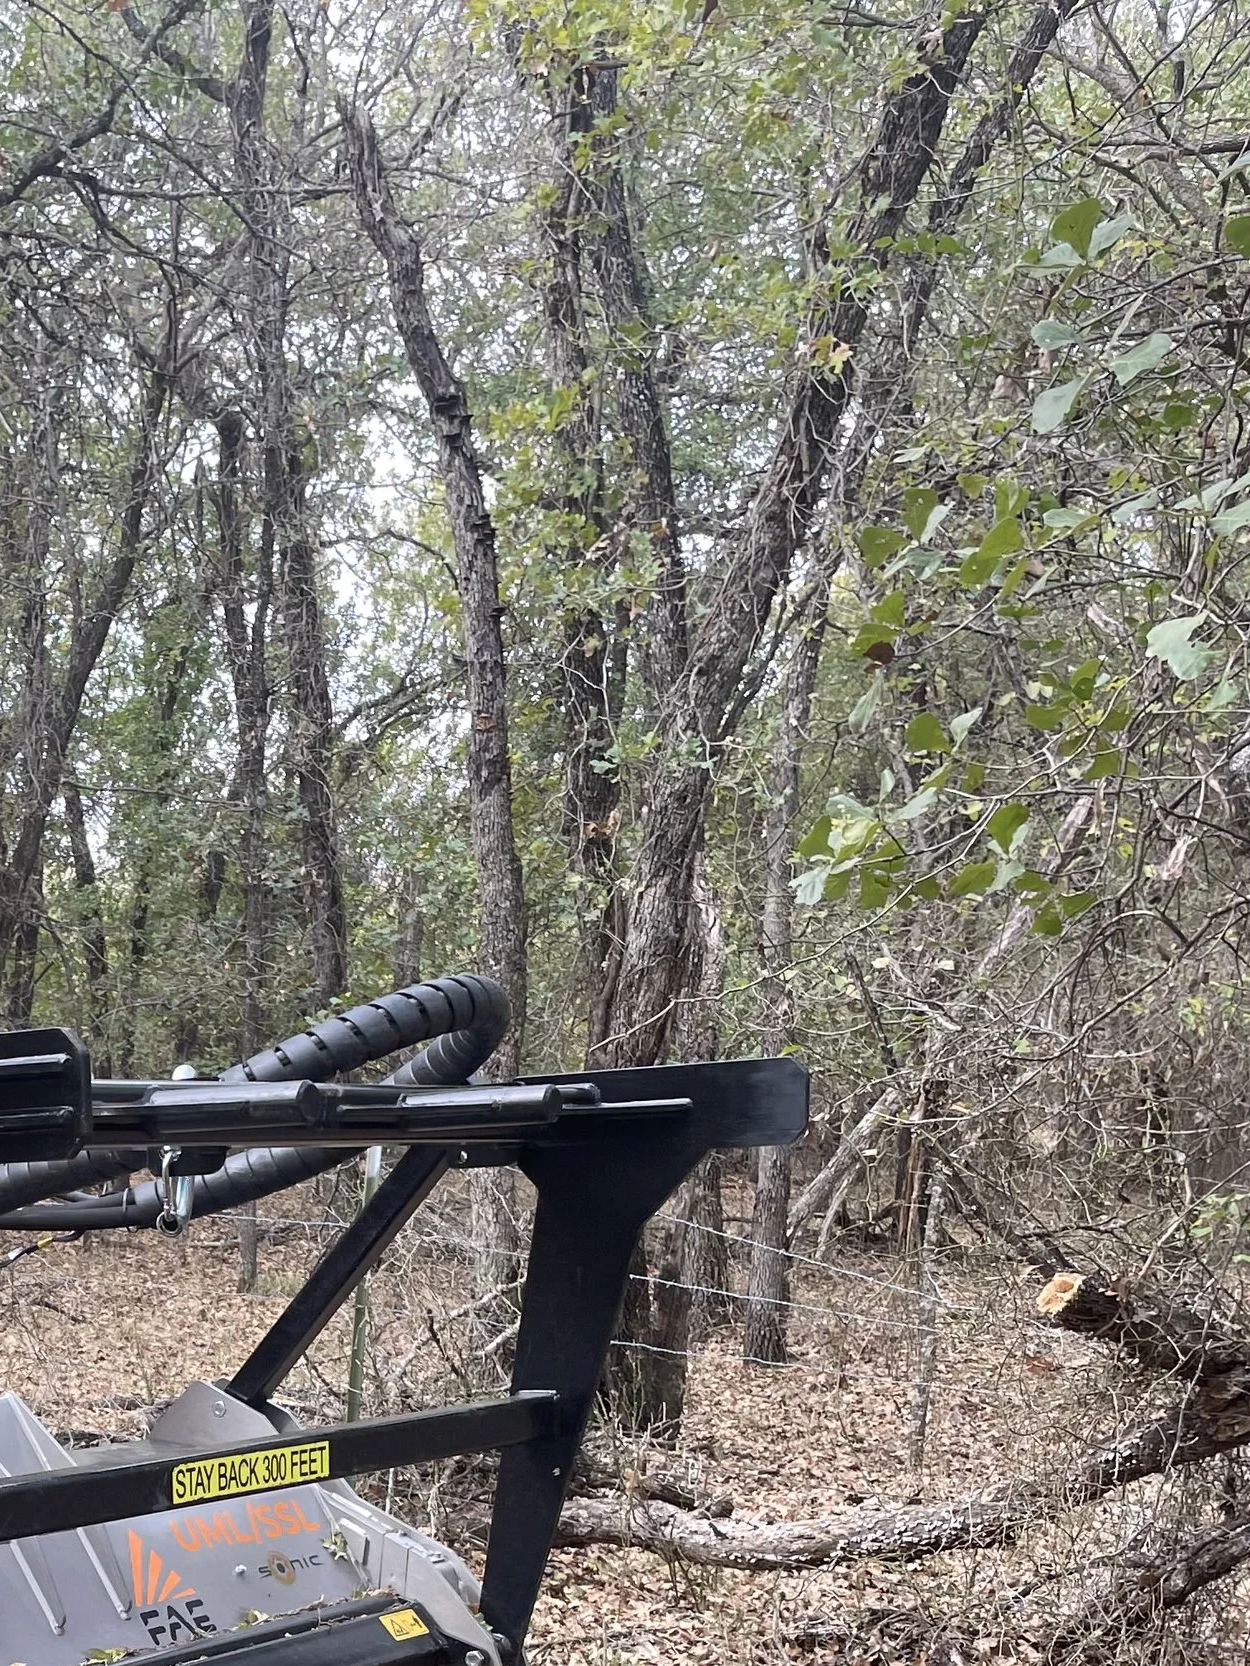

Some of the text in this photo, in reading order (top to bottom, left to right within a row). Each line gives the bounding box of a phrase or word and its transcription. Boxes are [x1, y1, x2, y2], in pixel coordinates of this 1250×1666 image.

[175, 1446, 327, 1499] STAY BACK 300 FEET
[168, 1499, 322, 1552] UML/SSL
[139, 1599, 218, 1646] FAE
